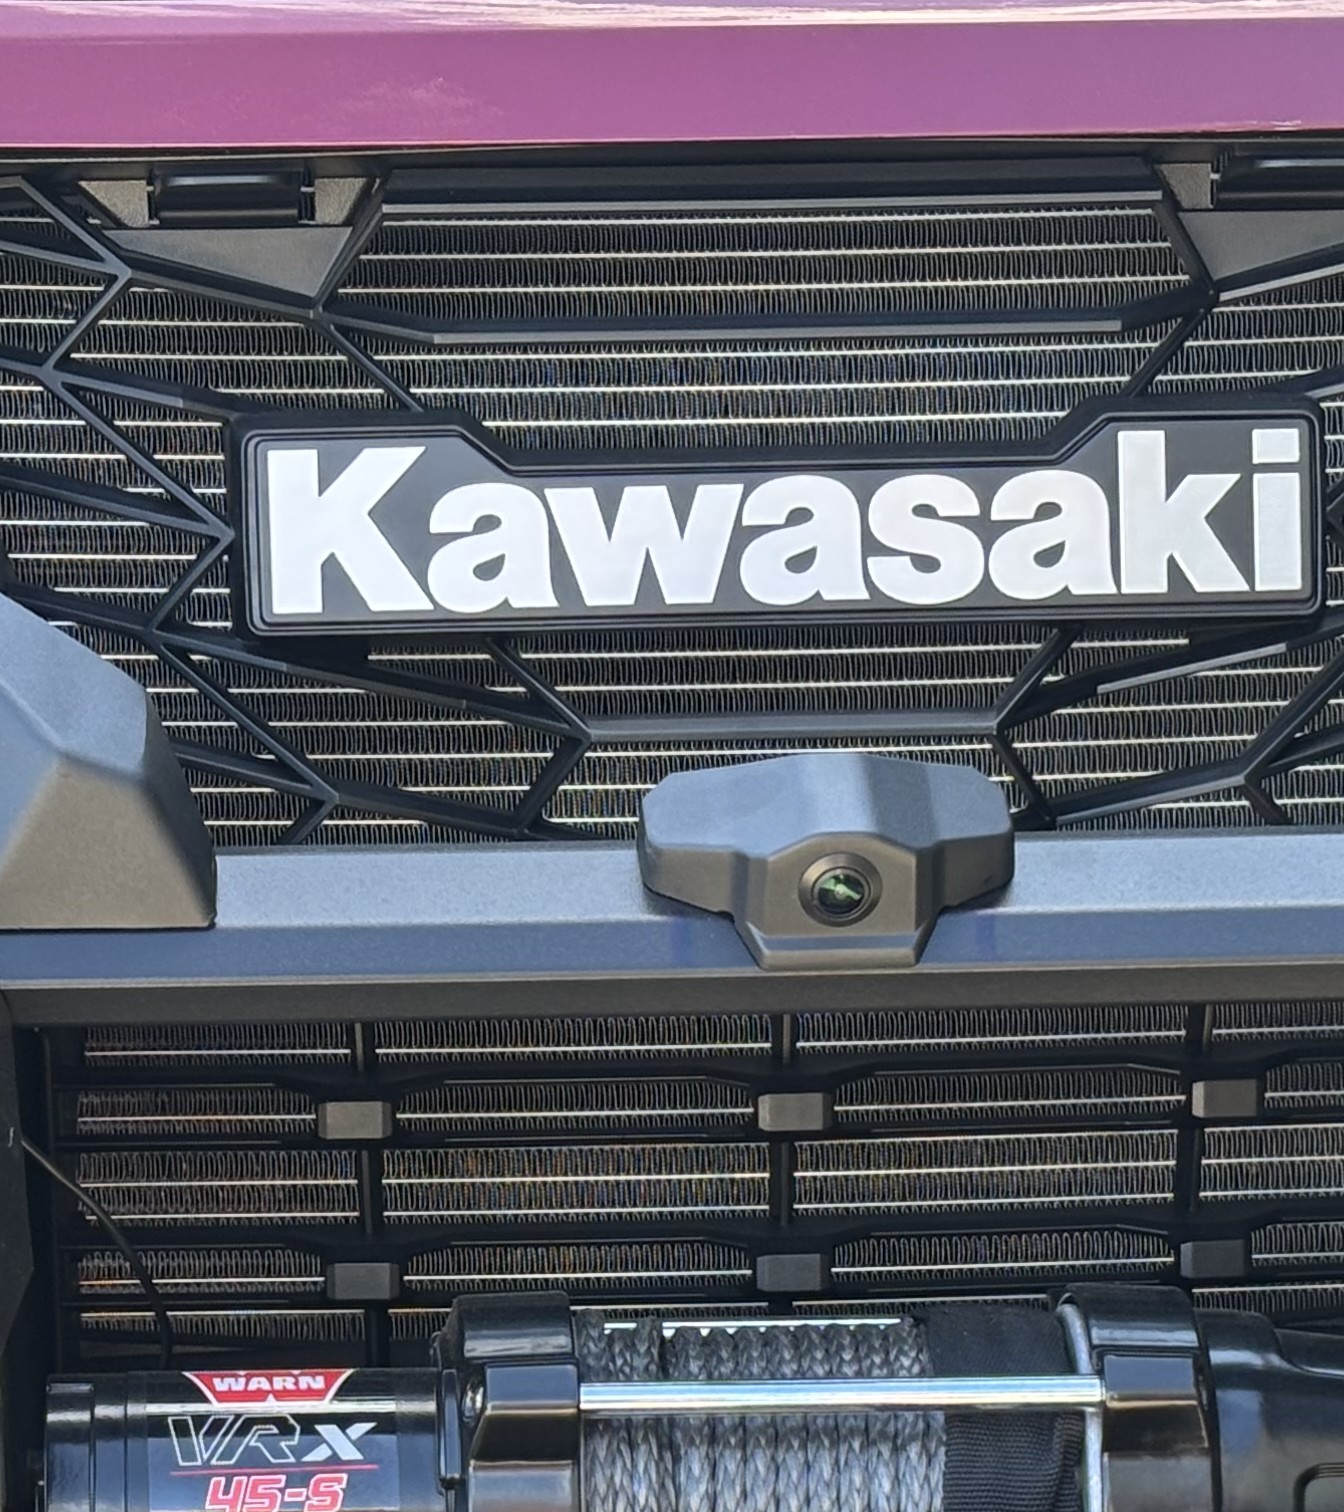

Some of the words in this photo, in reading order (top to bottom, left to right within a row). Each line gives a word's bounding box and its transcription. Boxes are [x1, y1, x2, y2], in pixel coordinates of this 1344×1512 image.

[265, 428, 1303, 616] Kawasaki
[213, 1374, 326, 1392] WARN
[168, 1413, 378, 1467] VRX
